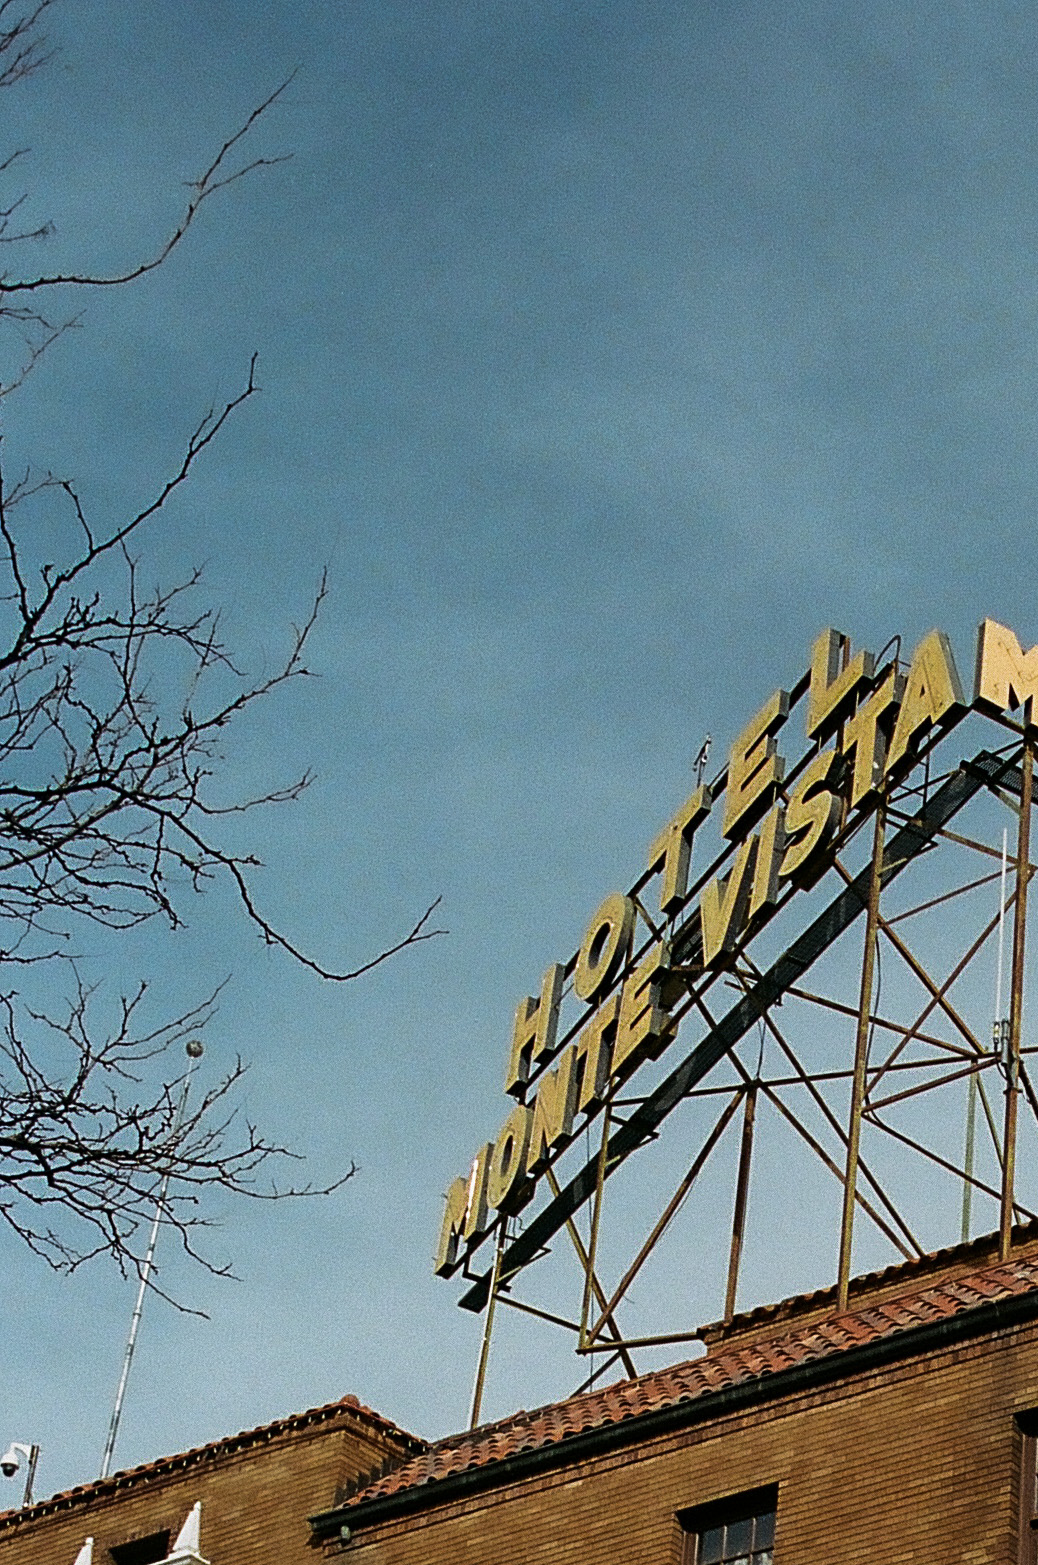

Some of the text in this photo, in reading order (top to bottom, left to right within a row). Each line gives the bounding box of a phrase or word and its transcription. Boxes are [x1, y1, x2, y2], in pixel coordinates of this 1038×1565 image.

[434, 628, 970, 1279] MONTE VISTA
[504, 626, 876, 1098] HOTEL
